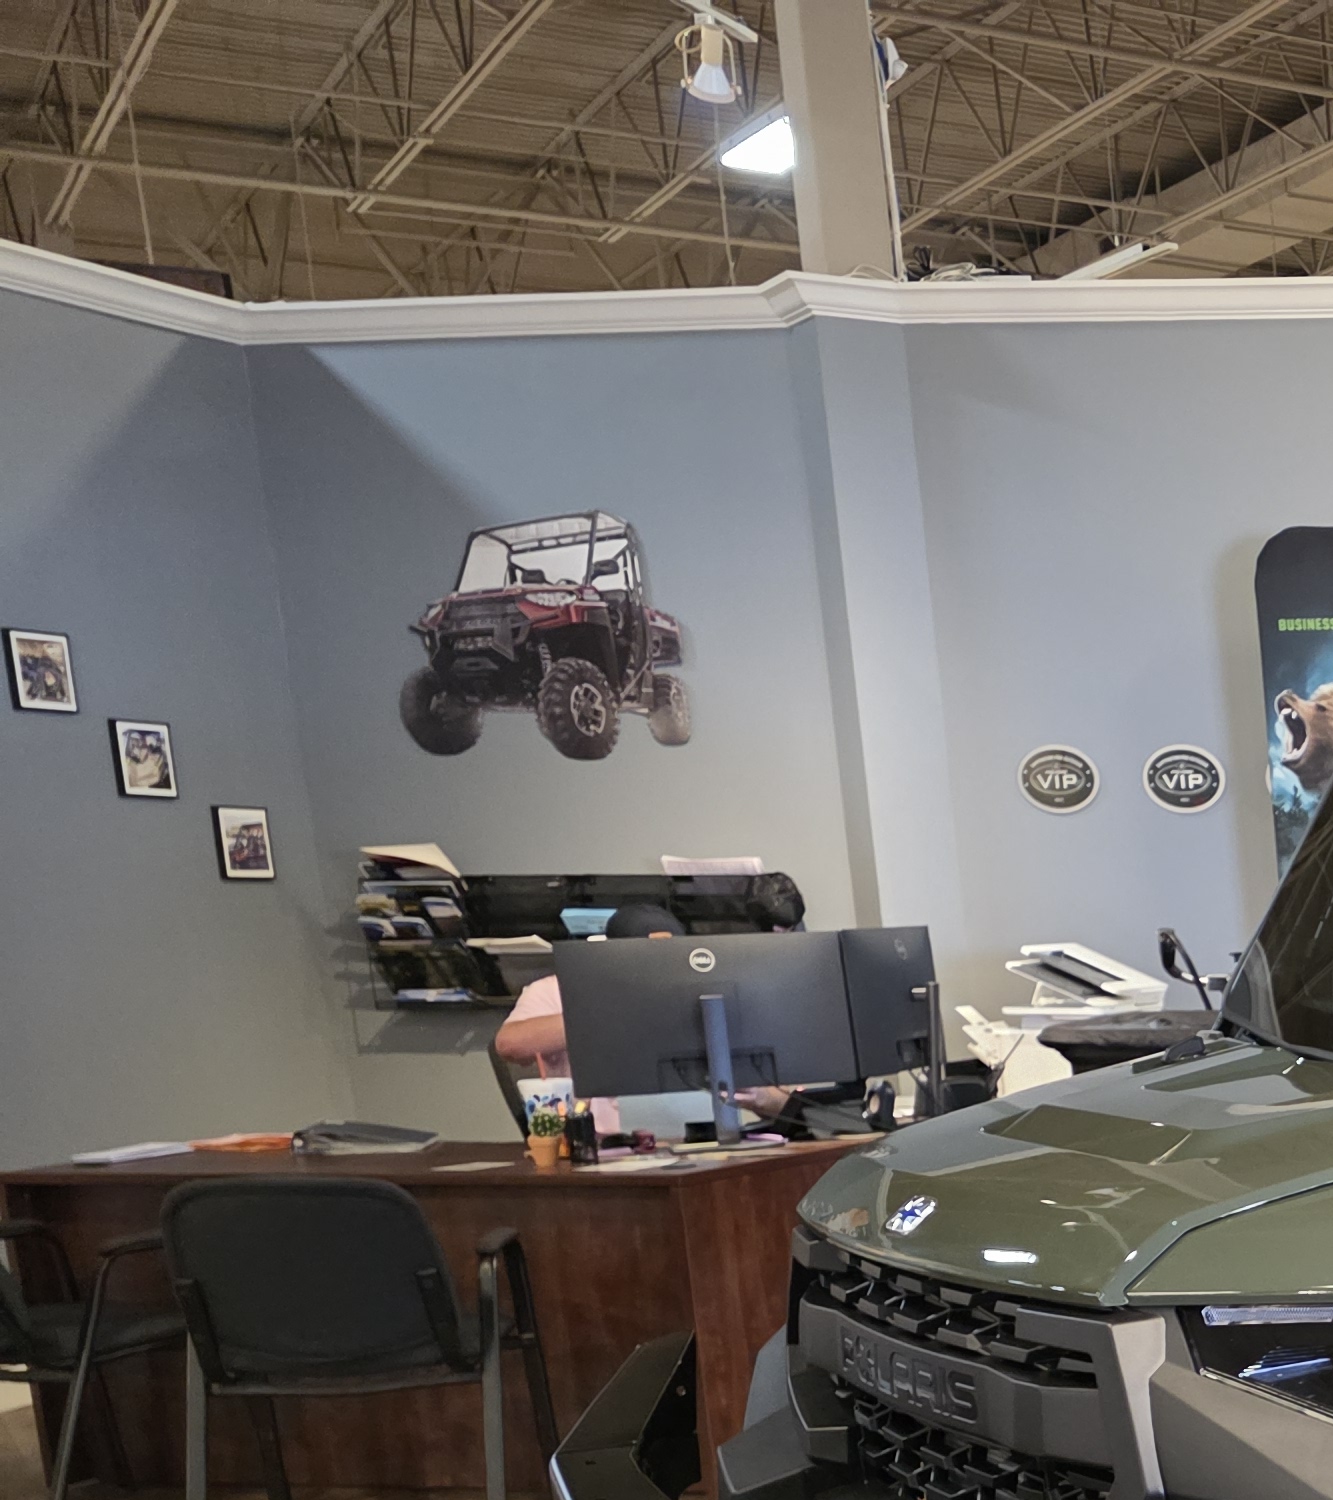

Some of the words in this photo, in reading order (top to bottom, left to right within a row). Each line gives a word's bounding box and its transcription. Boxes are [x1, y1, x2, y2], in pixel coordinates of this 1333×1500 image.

[1036, 773, 1078, 790] VIP
[1161, 773, 1203, 790] VIP
[839, 1326, 979, 1425] POLARIS
